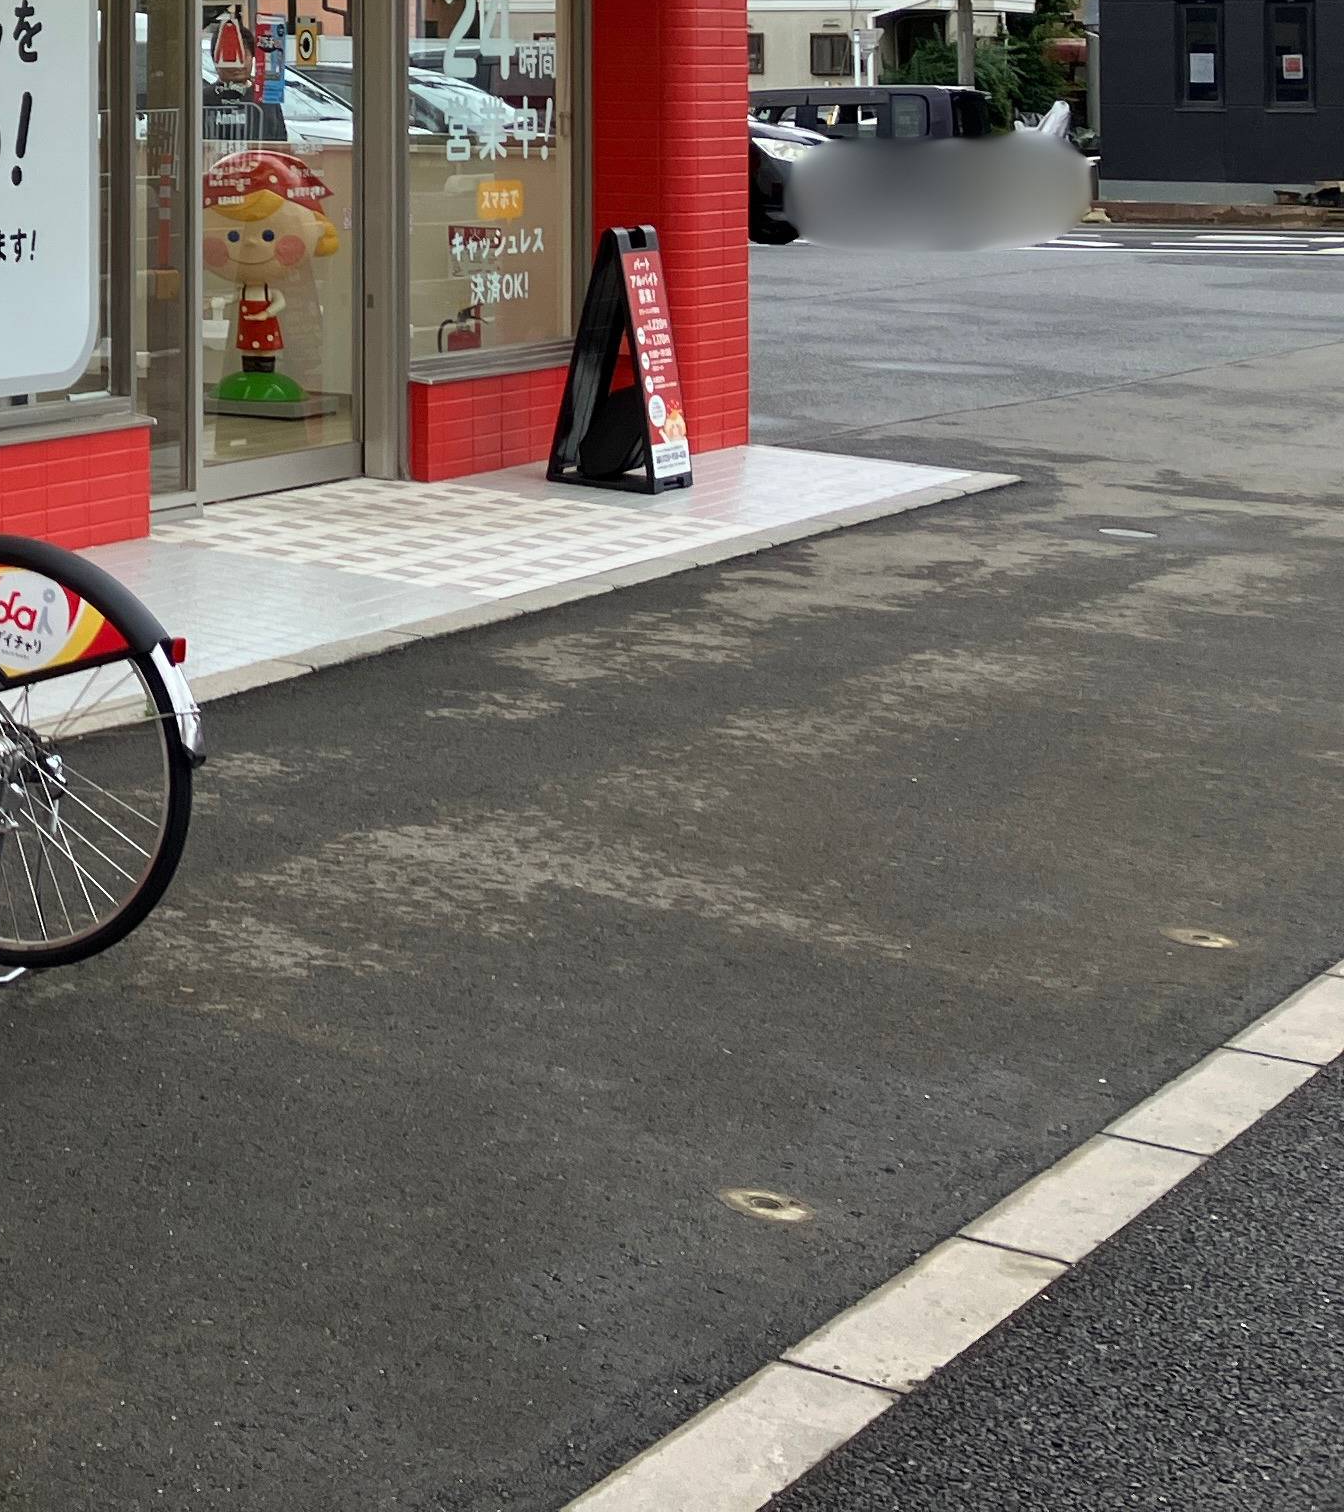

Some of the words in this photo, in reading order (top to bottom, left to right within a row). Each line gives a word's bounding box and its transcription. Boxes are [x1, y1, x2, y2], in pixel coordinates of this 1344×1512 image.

[481, 189, 520, 209] スマホで
[451, 228, 544, 262] キャッシュレス
[470, 271, 529, 306] 決済OK!
